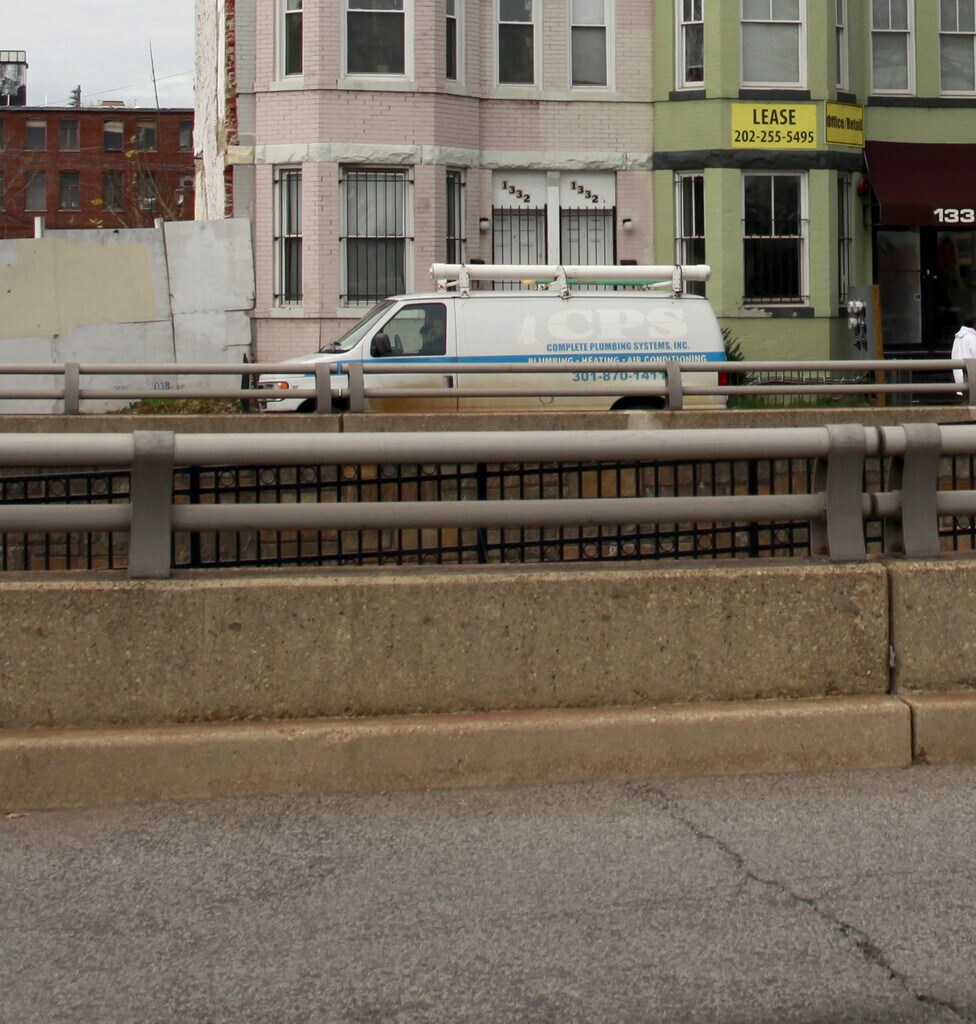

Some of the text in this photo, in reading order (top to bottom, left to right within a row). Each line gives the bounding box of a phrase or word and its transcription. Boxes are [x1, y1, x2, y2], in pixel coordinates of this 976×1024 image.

[752, 108, 797, 125] LEASE
[734, 129, 814, 143] 202-255-5495
[501, 180, 531, 203] 1332
[570, 181, 599, 204] 1332
[547, 308, 688, 340] CPS
[546, 343, 588, 352] COMPLETE
[590, 342, 632, 351] PLUMBING
[674, 341, 690, 350] INC.
